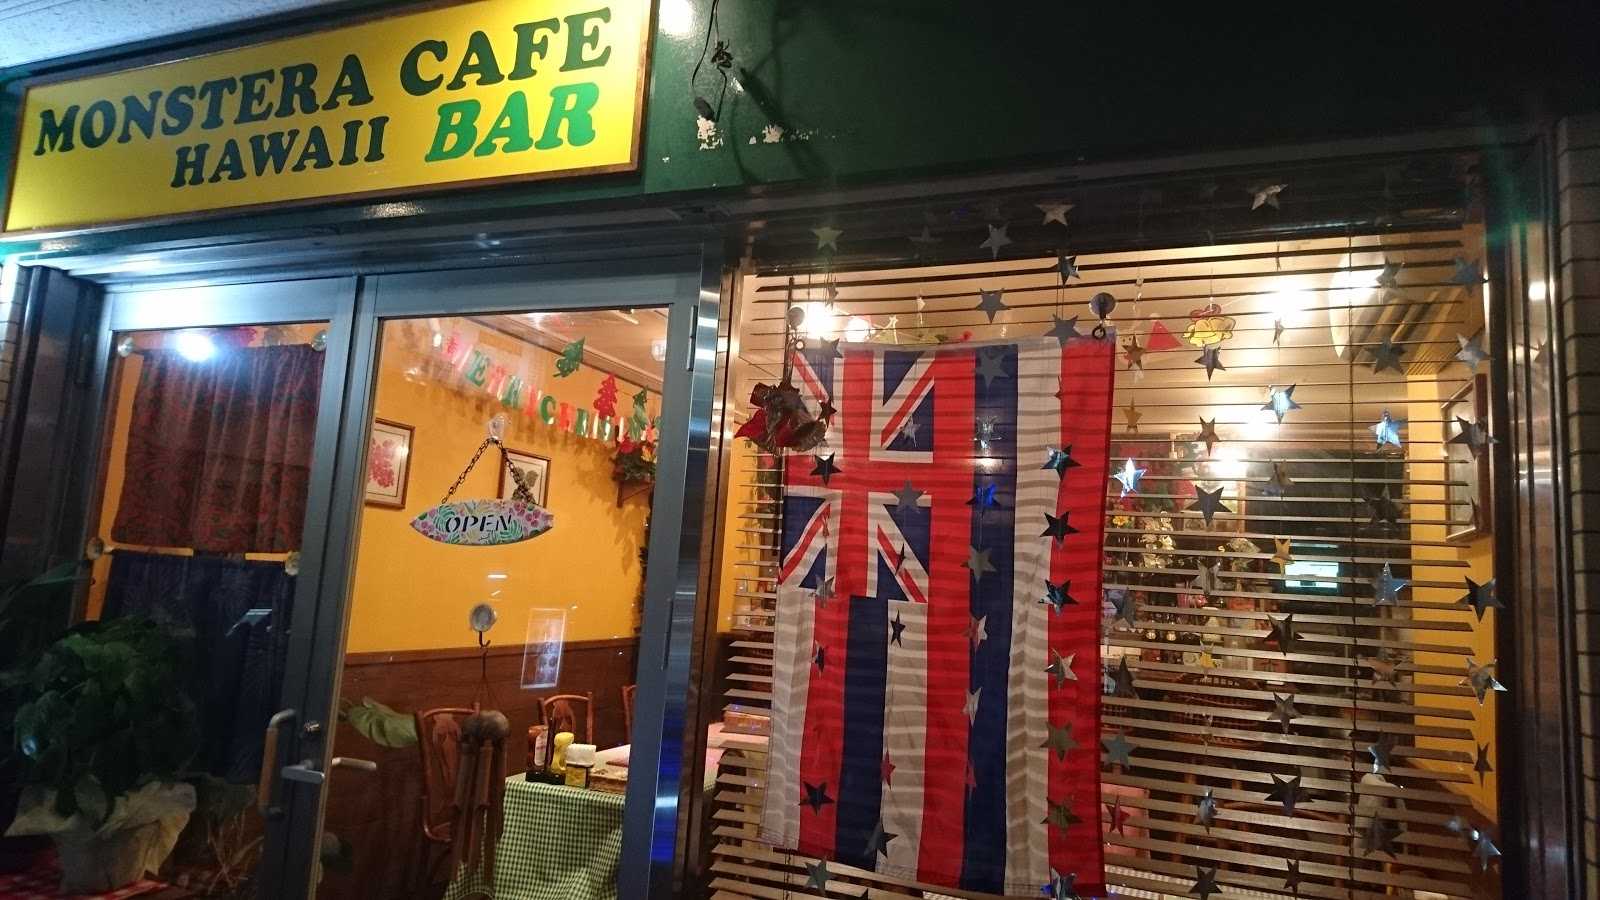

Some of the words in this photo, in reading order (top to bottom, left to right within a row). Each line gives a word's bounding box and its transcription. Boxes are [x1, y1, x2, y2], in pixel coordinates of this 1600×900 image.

[34, 54, 373, 157] MONSTERA
[400, 8, 612, 97] CAFE
[170, 116, 389, 189] HAWAII
[425, 82, 600, 163] BAR
[444, 513, 512, 533] OPEN
